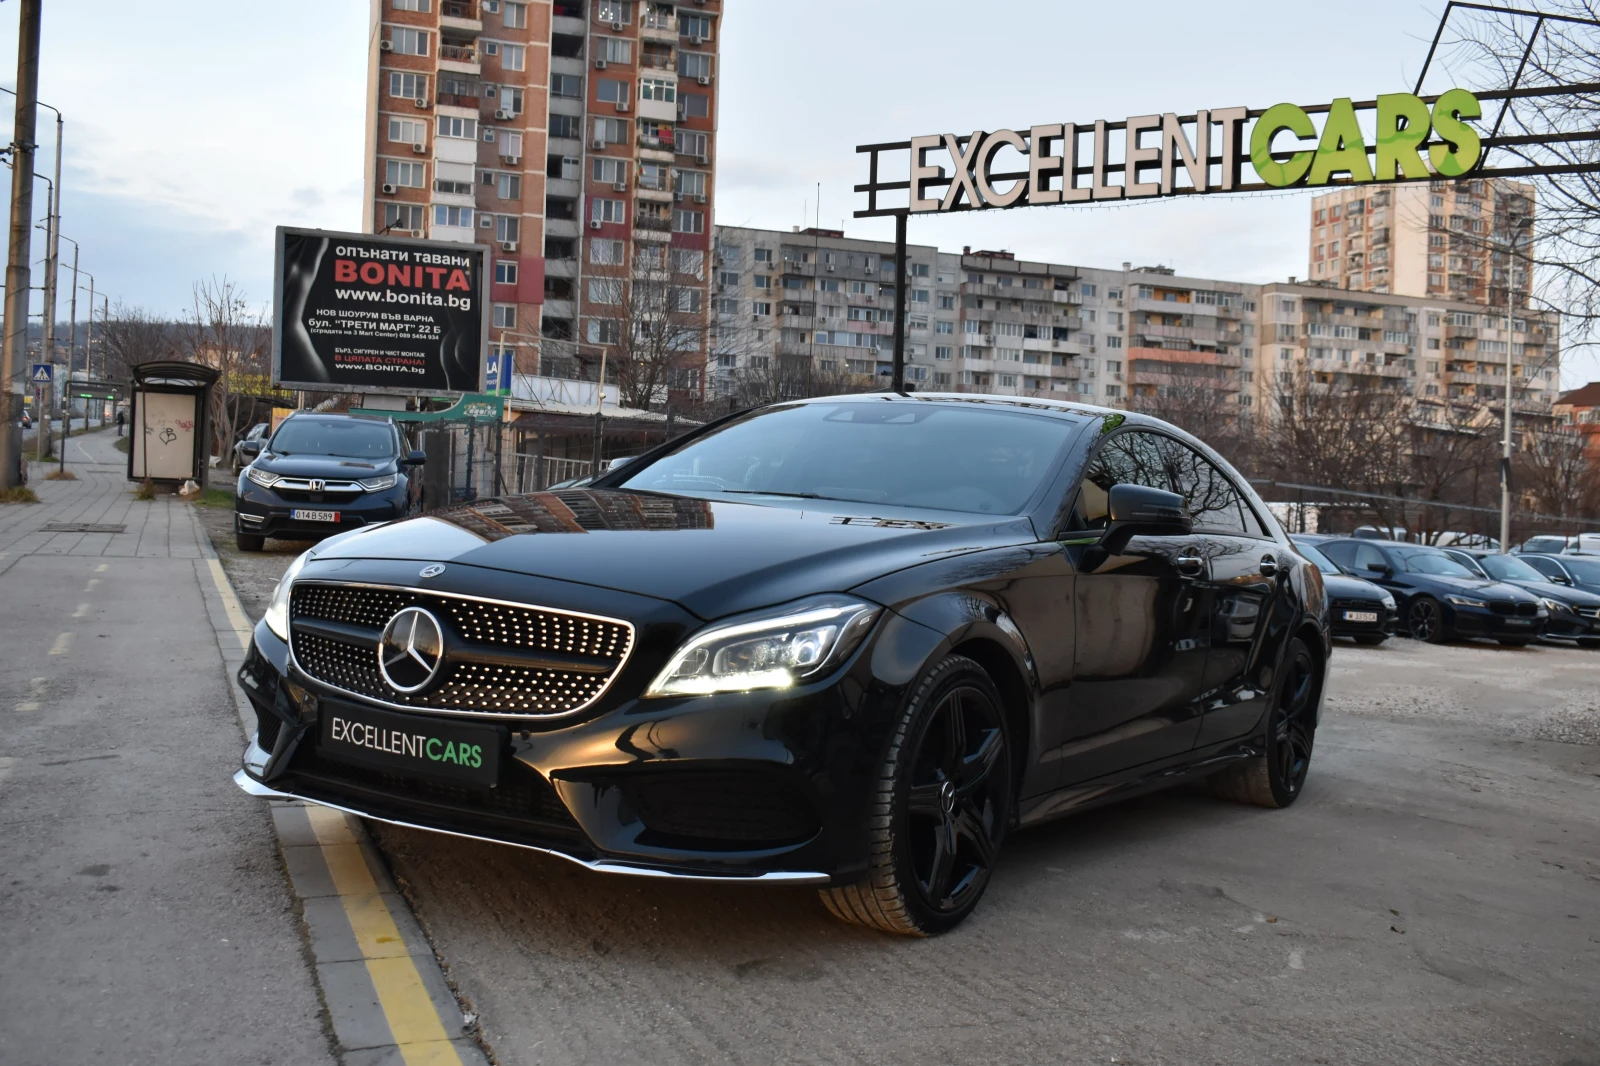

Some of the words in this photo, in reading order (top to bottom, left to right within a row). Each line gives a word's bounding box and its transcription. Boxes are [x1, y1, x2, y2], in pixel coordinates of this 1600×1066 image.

[336, 246, 409, 262] опънати
[413, 252, 470, 267] тавани
[335, 259, 470, 291] BONITA
[335, 289, 471, 311] www.bonita.bg
[316, 309, 336, 317] НОВ
[338, 310, 379, 319] ШОУРУМ
[381, 312, 401, 320] ВЪВ
[403, 314, 434, 323] ВАРНА
[308, 318, 332, 328] бул.
[418, 325, 431, 333] 22
[433, 326, 441, 334] Б
[344, 355, 382, 363] ЦЯЛАТА
[335, 363, 425, 374] www.BONITA.bg
